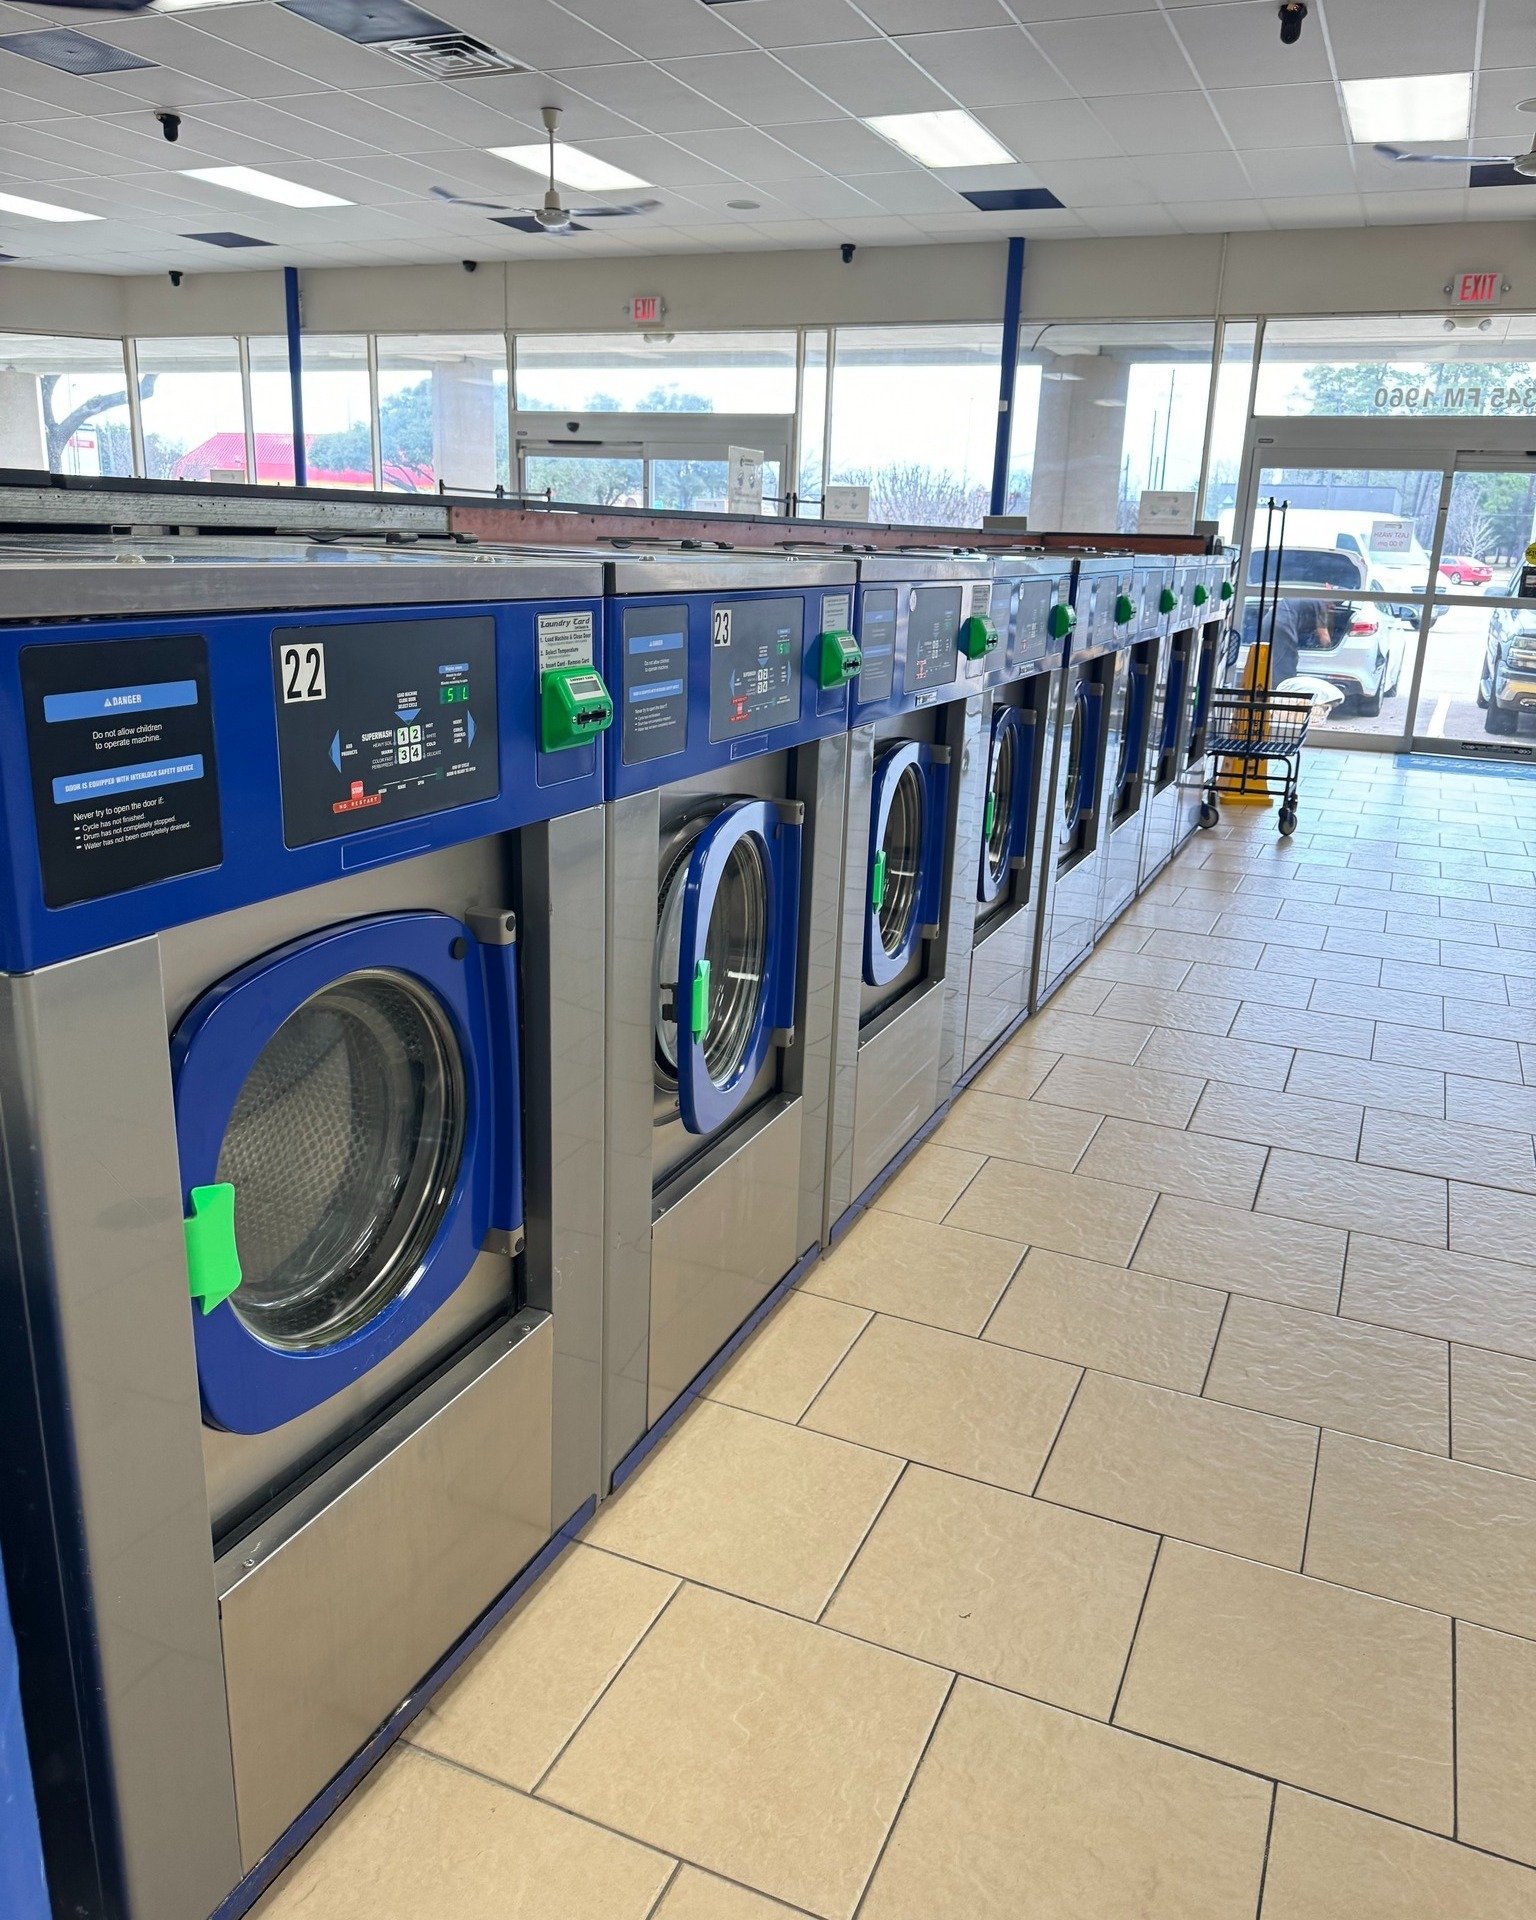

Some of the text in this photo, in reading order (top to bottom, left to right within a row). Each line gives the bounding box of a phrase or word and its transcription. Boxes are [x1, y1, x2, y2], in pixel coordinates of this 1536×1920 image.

[1459, 273, 1497, 301] EXIT
[634, 298, 656, 319] EXIT
[541, 620, 571, 628] Laundry
[715, 613, 729, 644] 23
[285, 648, 322, 699] 22
[113, 694, 142, 707] DANGER
[93, 723, 162, 740] Do not allow children
[95, 734, 162, 750] to operate machine.
[362, 730, 392, 741] SUPERWASH
[65, 784, 81, 792] DOOR
[89, 778, 115, 789] EQUIPPED
[116, 775, 130, 783] WITH
[130, 771, 157, 781] INTERLOCK
[158, 767, 176, 776] SAFETY
[177, 764, 194, 773] DEVICE
[74, 812, 94, 822] Never
[96, 808, 105, 818] try
[114, 805, 130, 814] open
[131, 802, 141, 810] the
[143, 798, 156, 808] door
[351, 797, 378, 807] RESTART
[82, 813, 145, 832] Cycle has not finished.
[83, 815, 176, 841] Drum has not completely stopped.
[84, 821, 191, 850] Water has not been completely drained.
